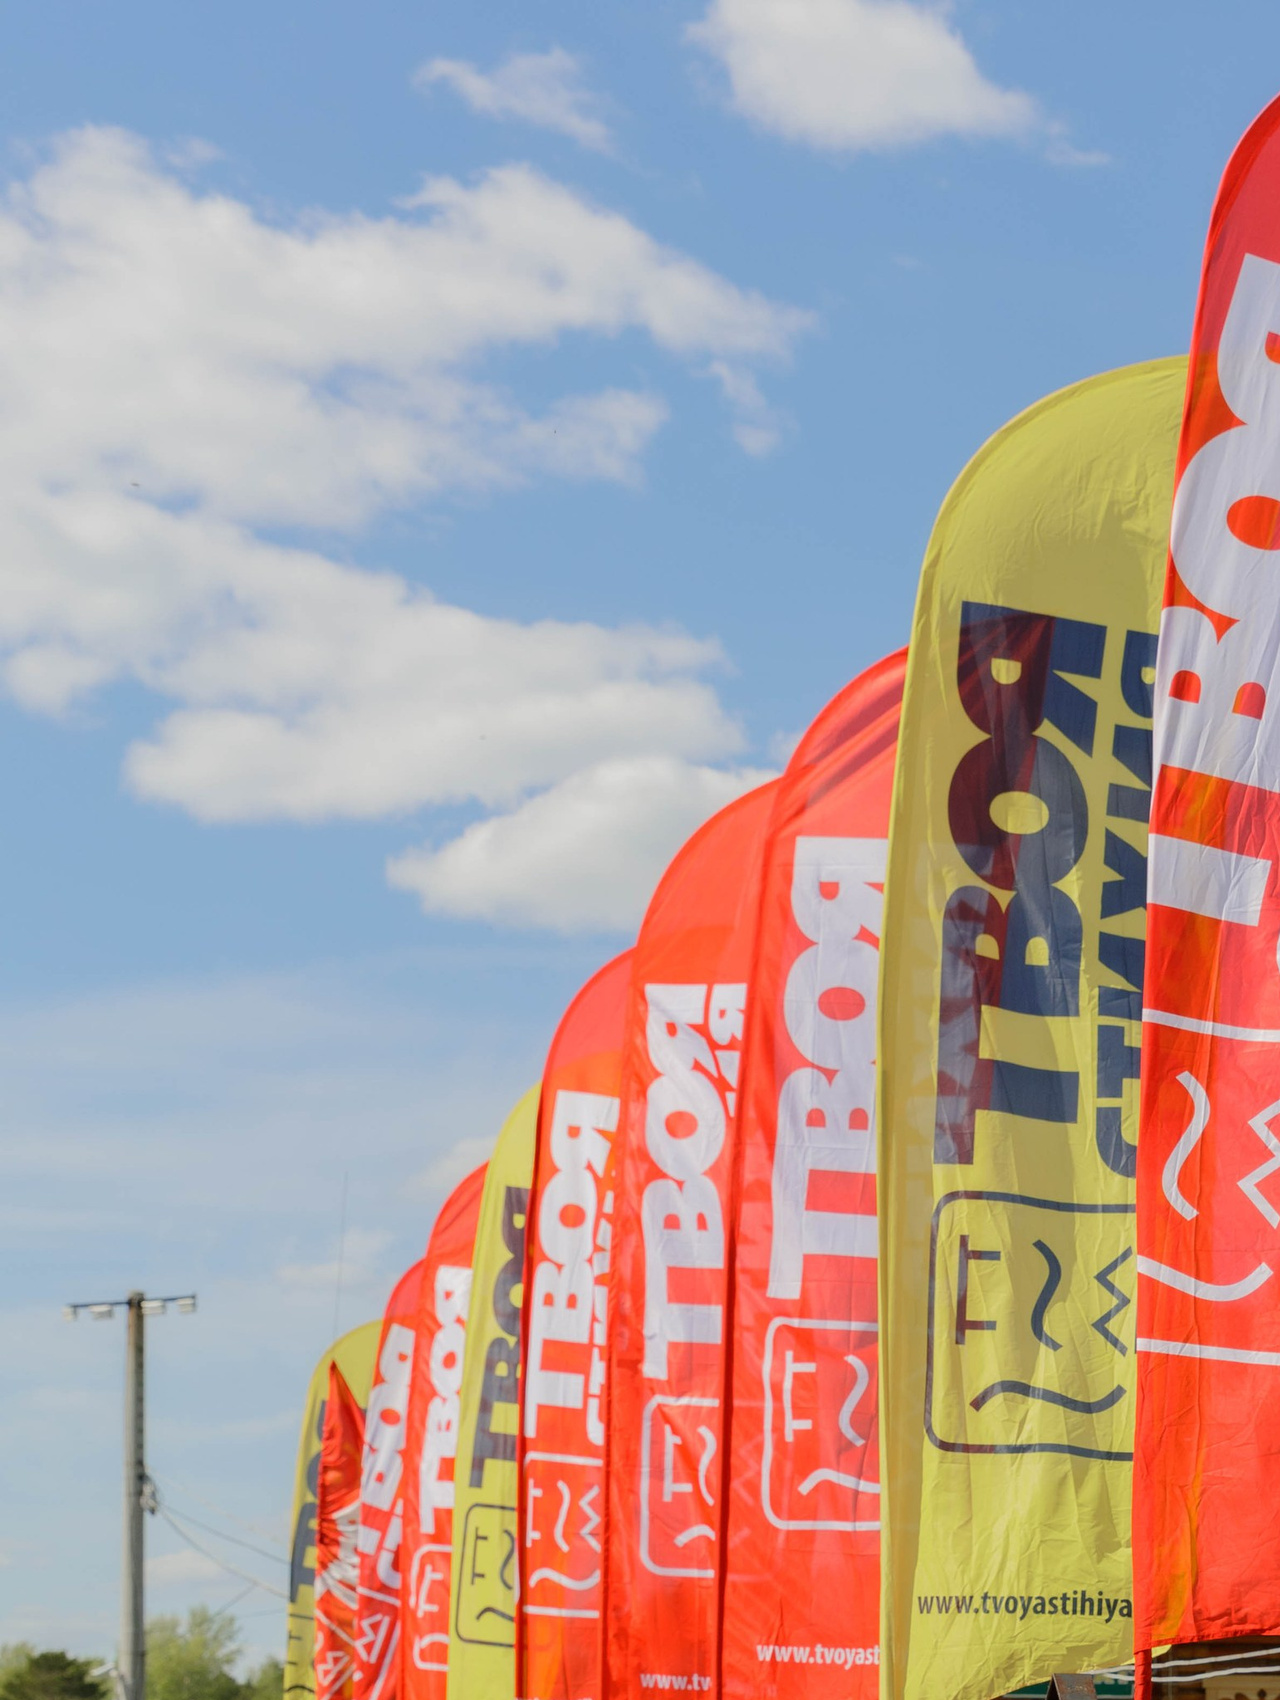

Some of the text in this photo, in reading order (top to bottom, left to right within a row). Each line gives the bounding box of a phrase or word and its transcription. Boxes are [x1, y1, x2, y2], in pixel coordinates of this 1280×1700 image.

[767, 836, 890, 1299] ТВОЯ
[933, 601, 1107, 1164] ТВОЯ
[524, 1090, 620, 1438] ТВОЯ
[643, 983, 726, 1380] ТВОЯ
